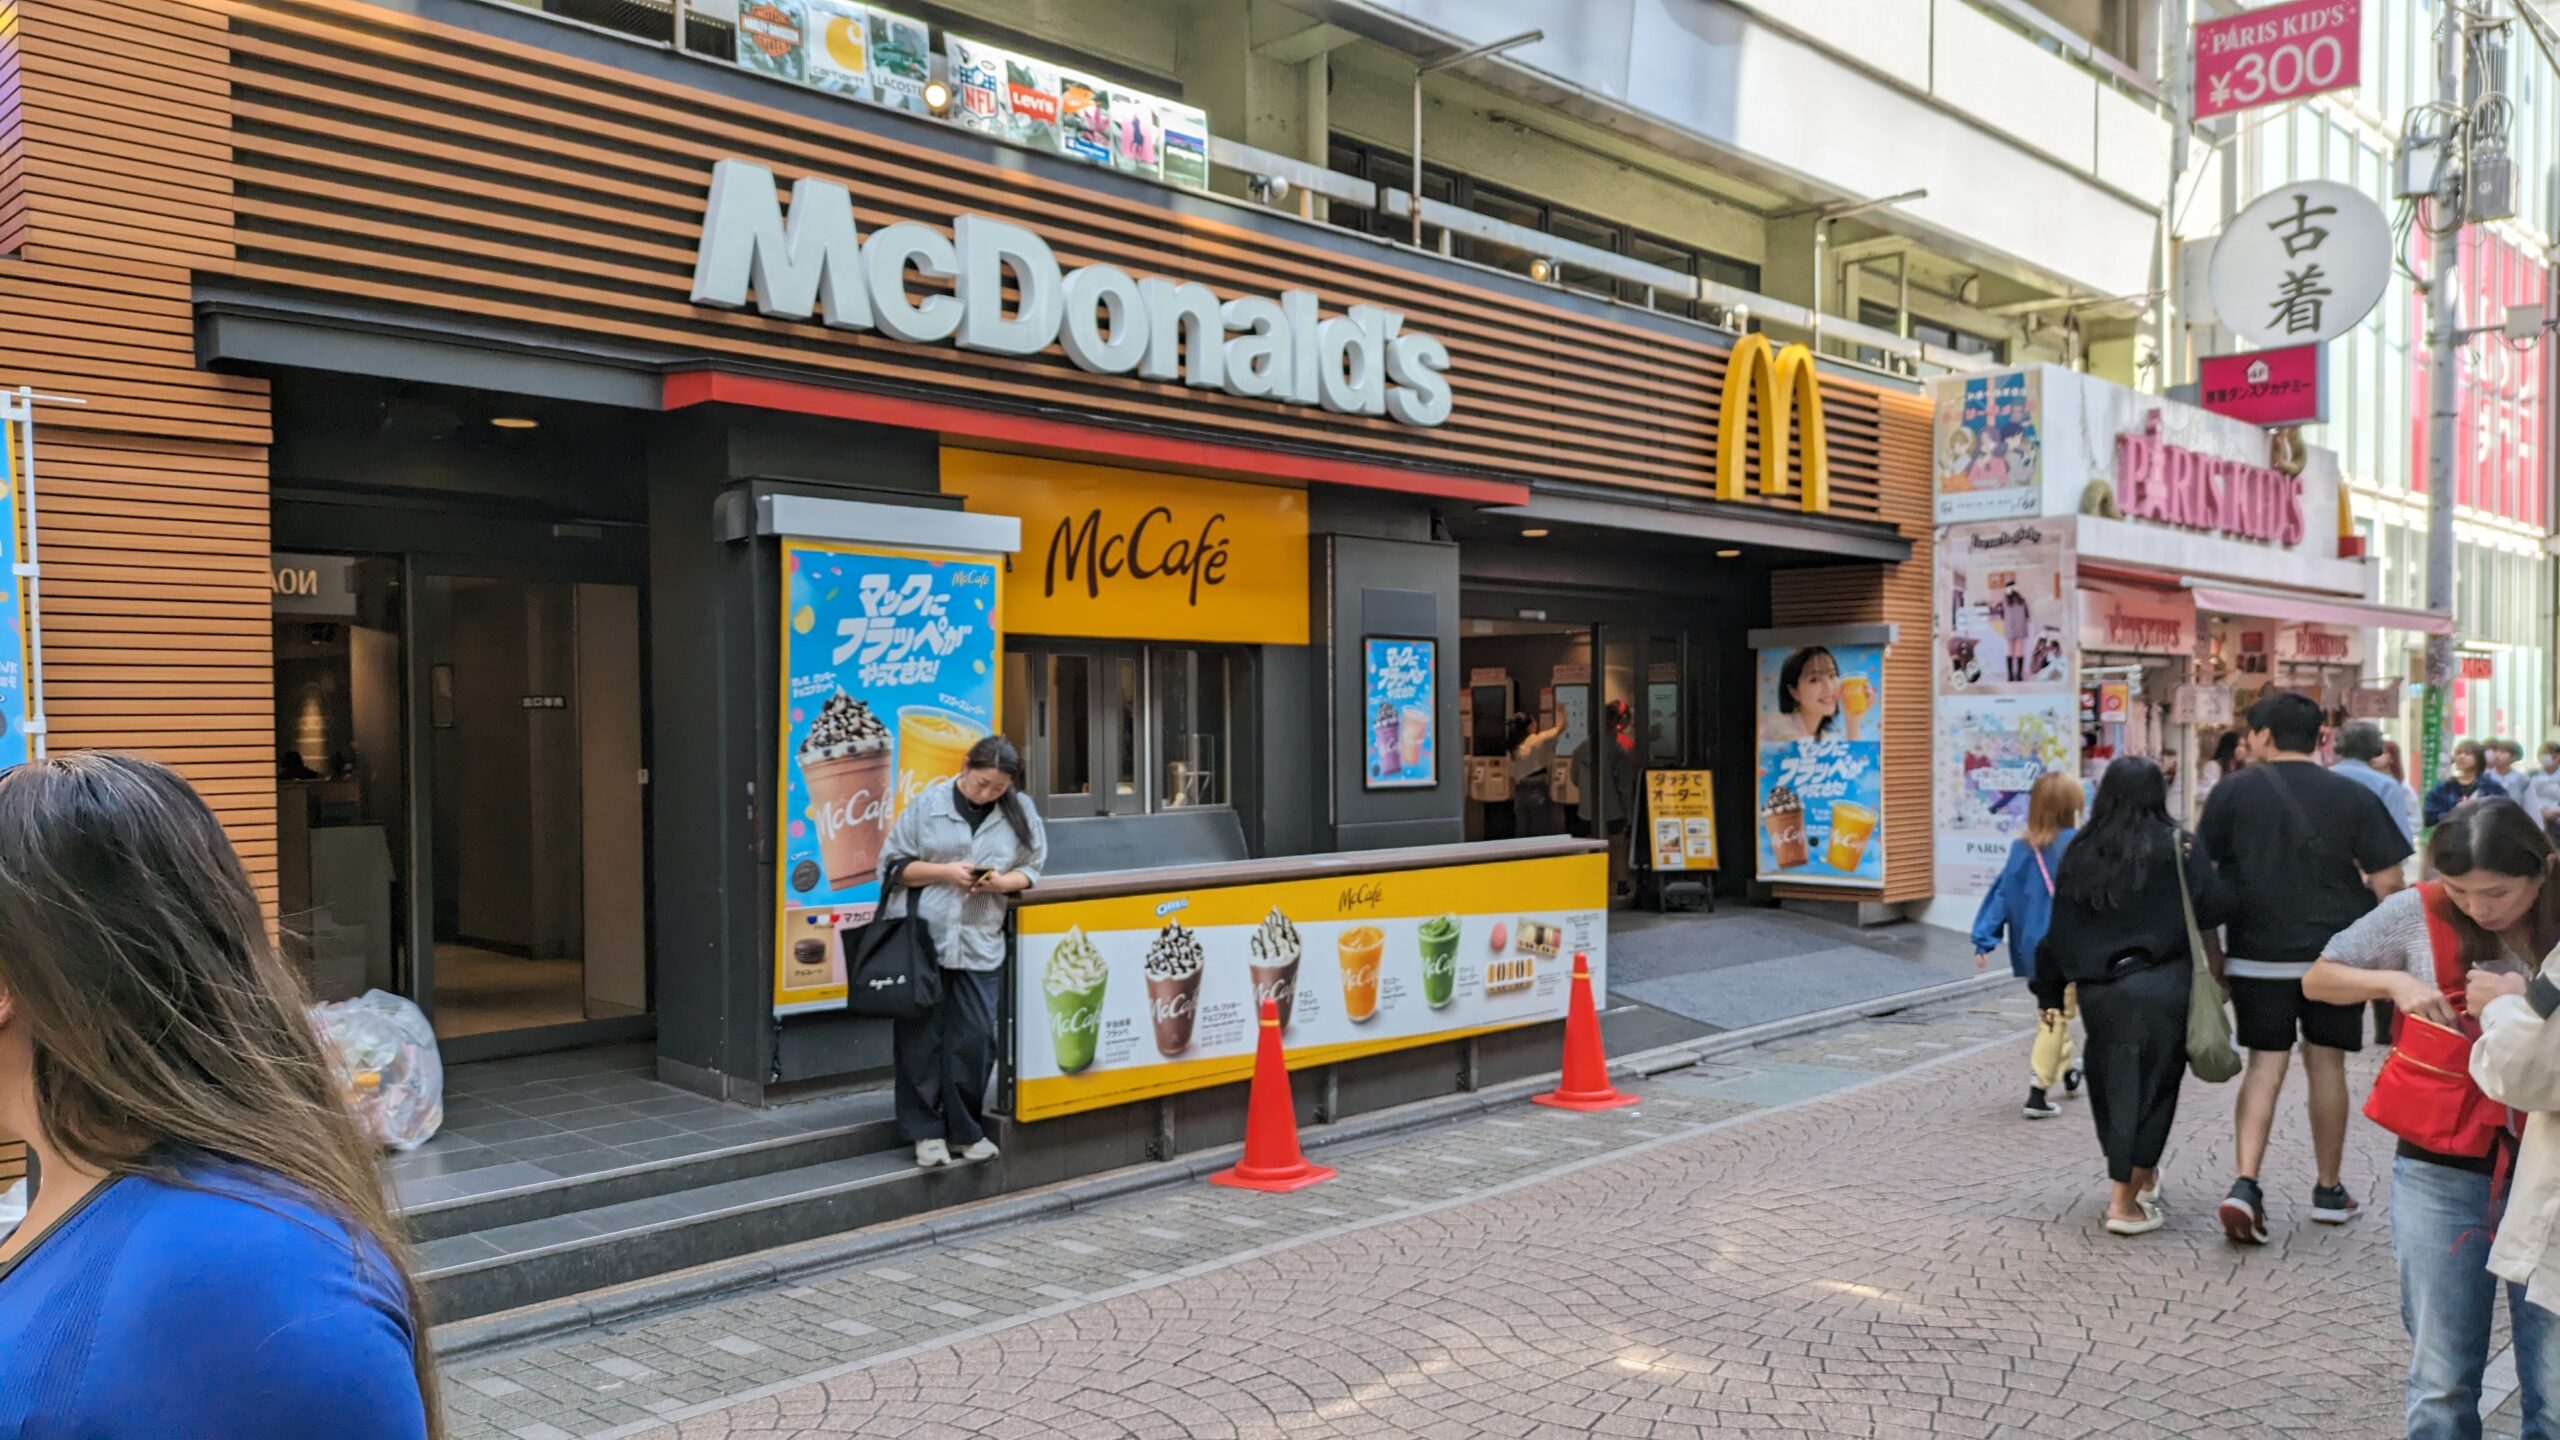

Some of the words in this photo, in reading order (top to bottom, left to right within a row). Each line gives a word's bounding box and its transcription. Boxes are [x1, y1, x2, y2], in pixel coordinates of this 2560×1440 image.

[2211, 22, 2278, 54] PARIS
[2281, 4, 2345, 38] KID'S
[2209, 35, 2342, 109] ¥300
[963, 85, 996, 117] NFL
[2266, 193, 2338, 336] 古着
[691, 157, 1452, 427] McDonald's
[2206, 379, 2312, 403] ダンスアカデミー
[1044, 506, 1230, 607] McCafé
[858, 573, 951, 617] マックに
[951, 569, 990, 588] McCafé
[832, 615, 972, 666] フラッペが
[1654, 772, 1703, 787] タッチで
[1965, 842, 2006, 854] PARIS
[1338, 882, 1383, 912] McCafé
[843, 911, 873, 923] マカロ
